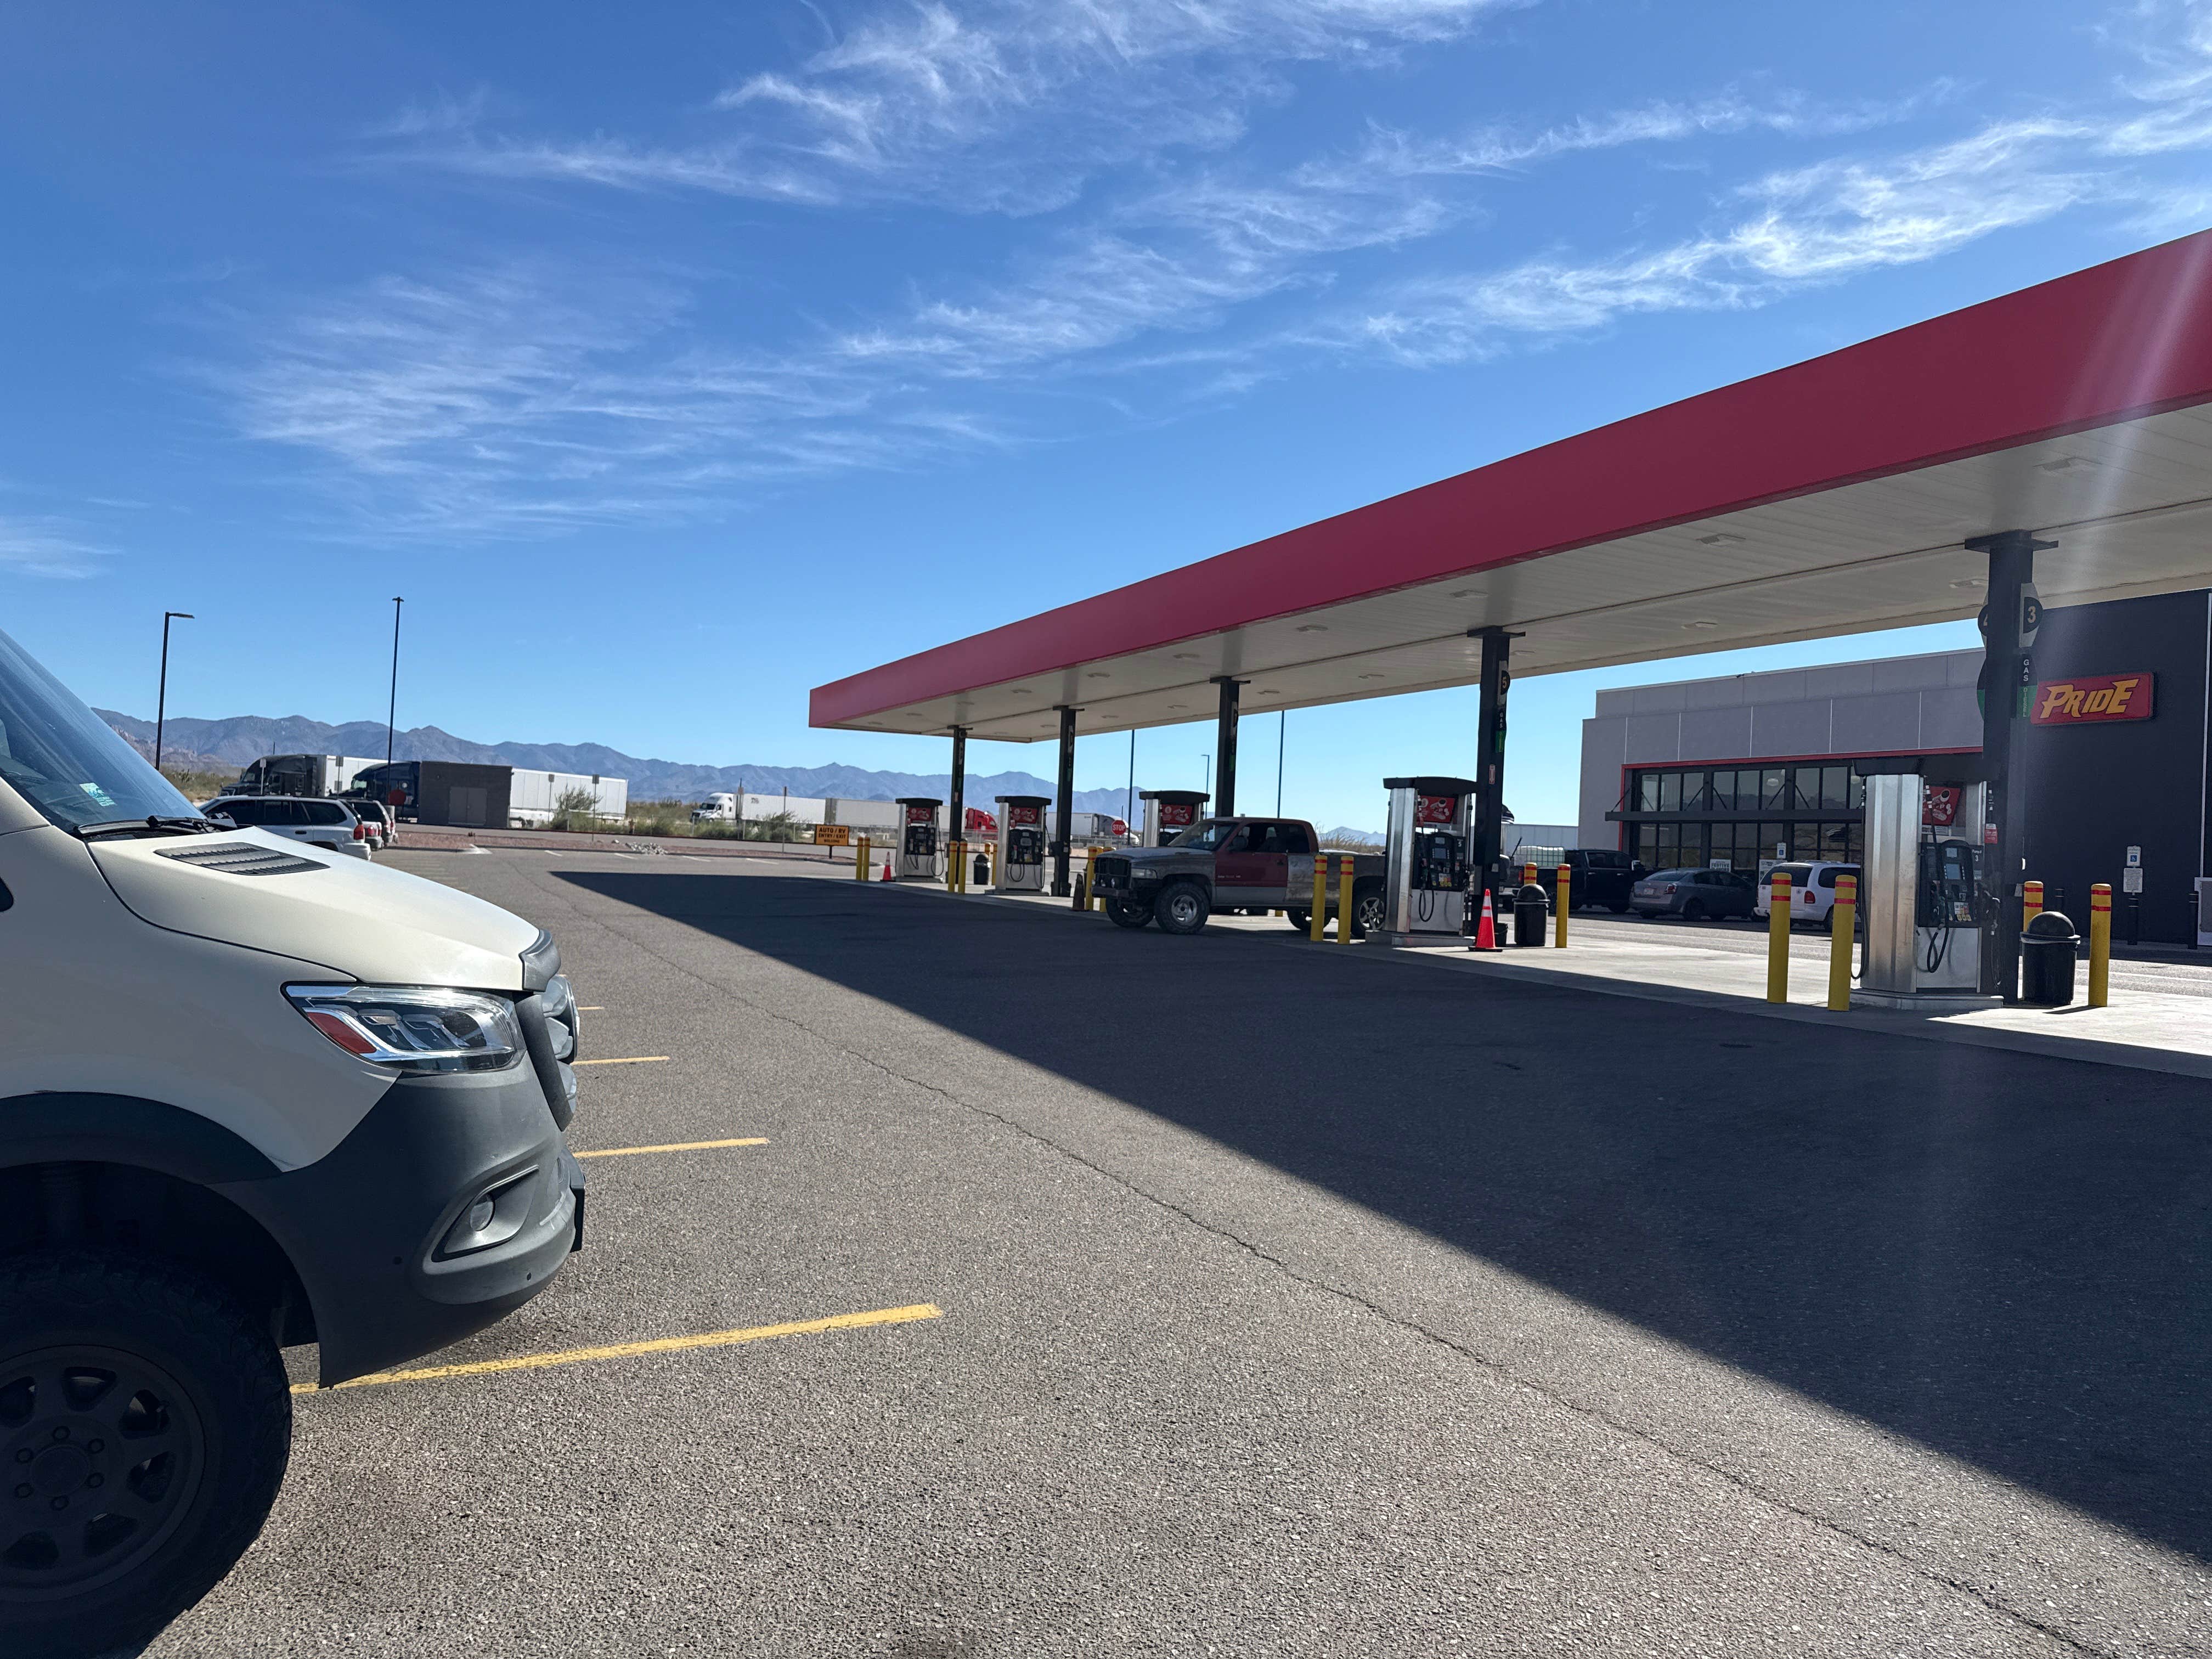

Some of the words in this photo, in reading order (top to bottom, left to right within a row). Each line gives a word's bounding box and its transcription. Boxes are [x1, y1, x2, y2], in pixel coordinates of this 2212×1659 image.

[2027, 606, 2036, 624] 3
[1502, 677, 1508, 689] 5
[2039, 678, 2140, 719] PRIDE
